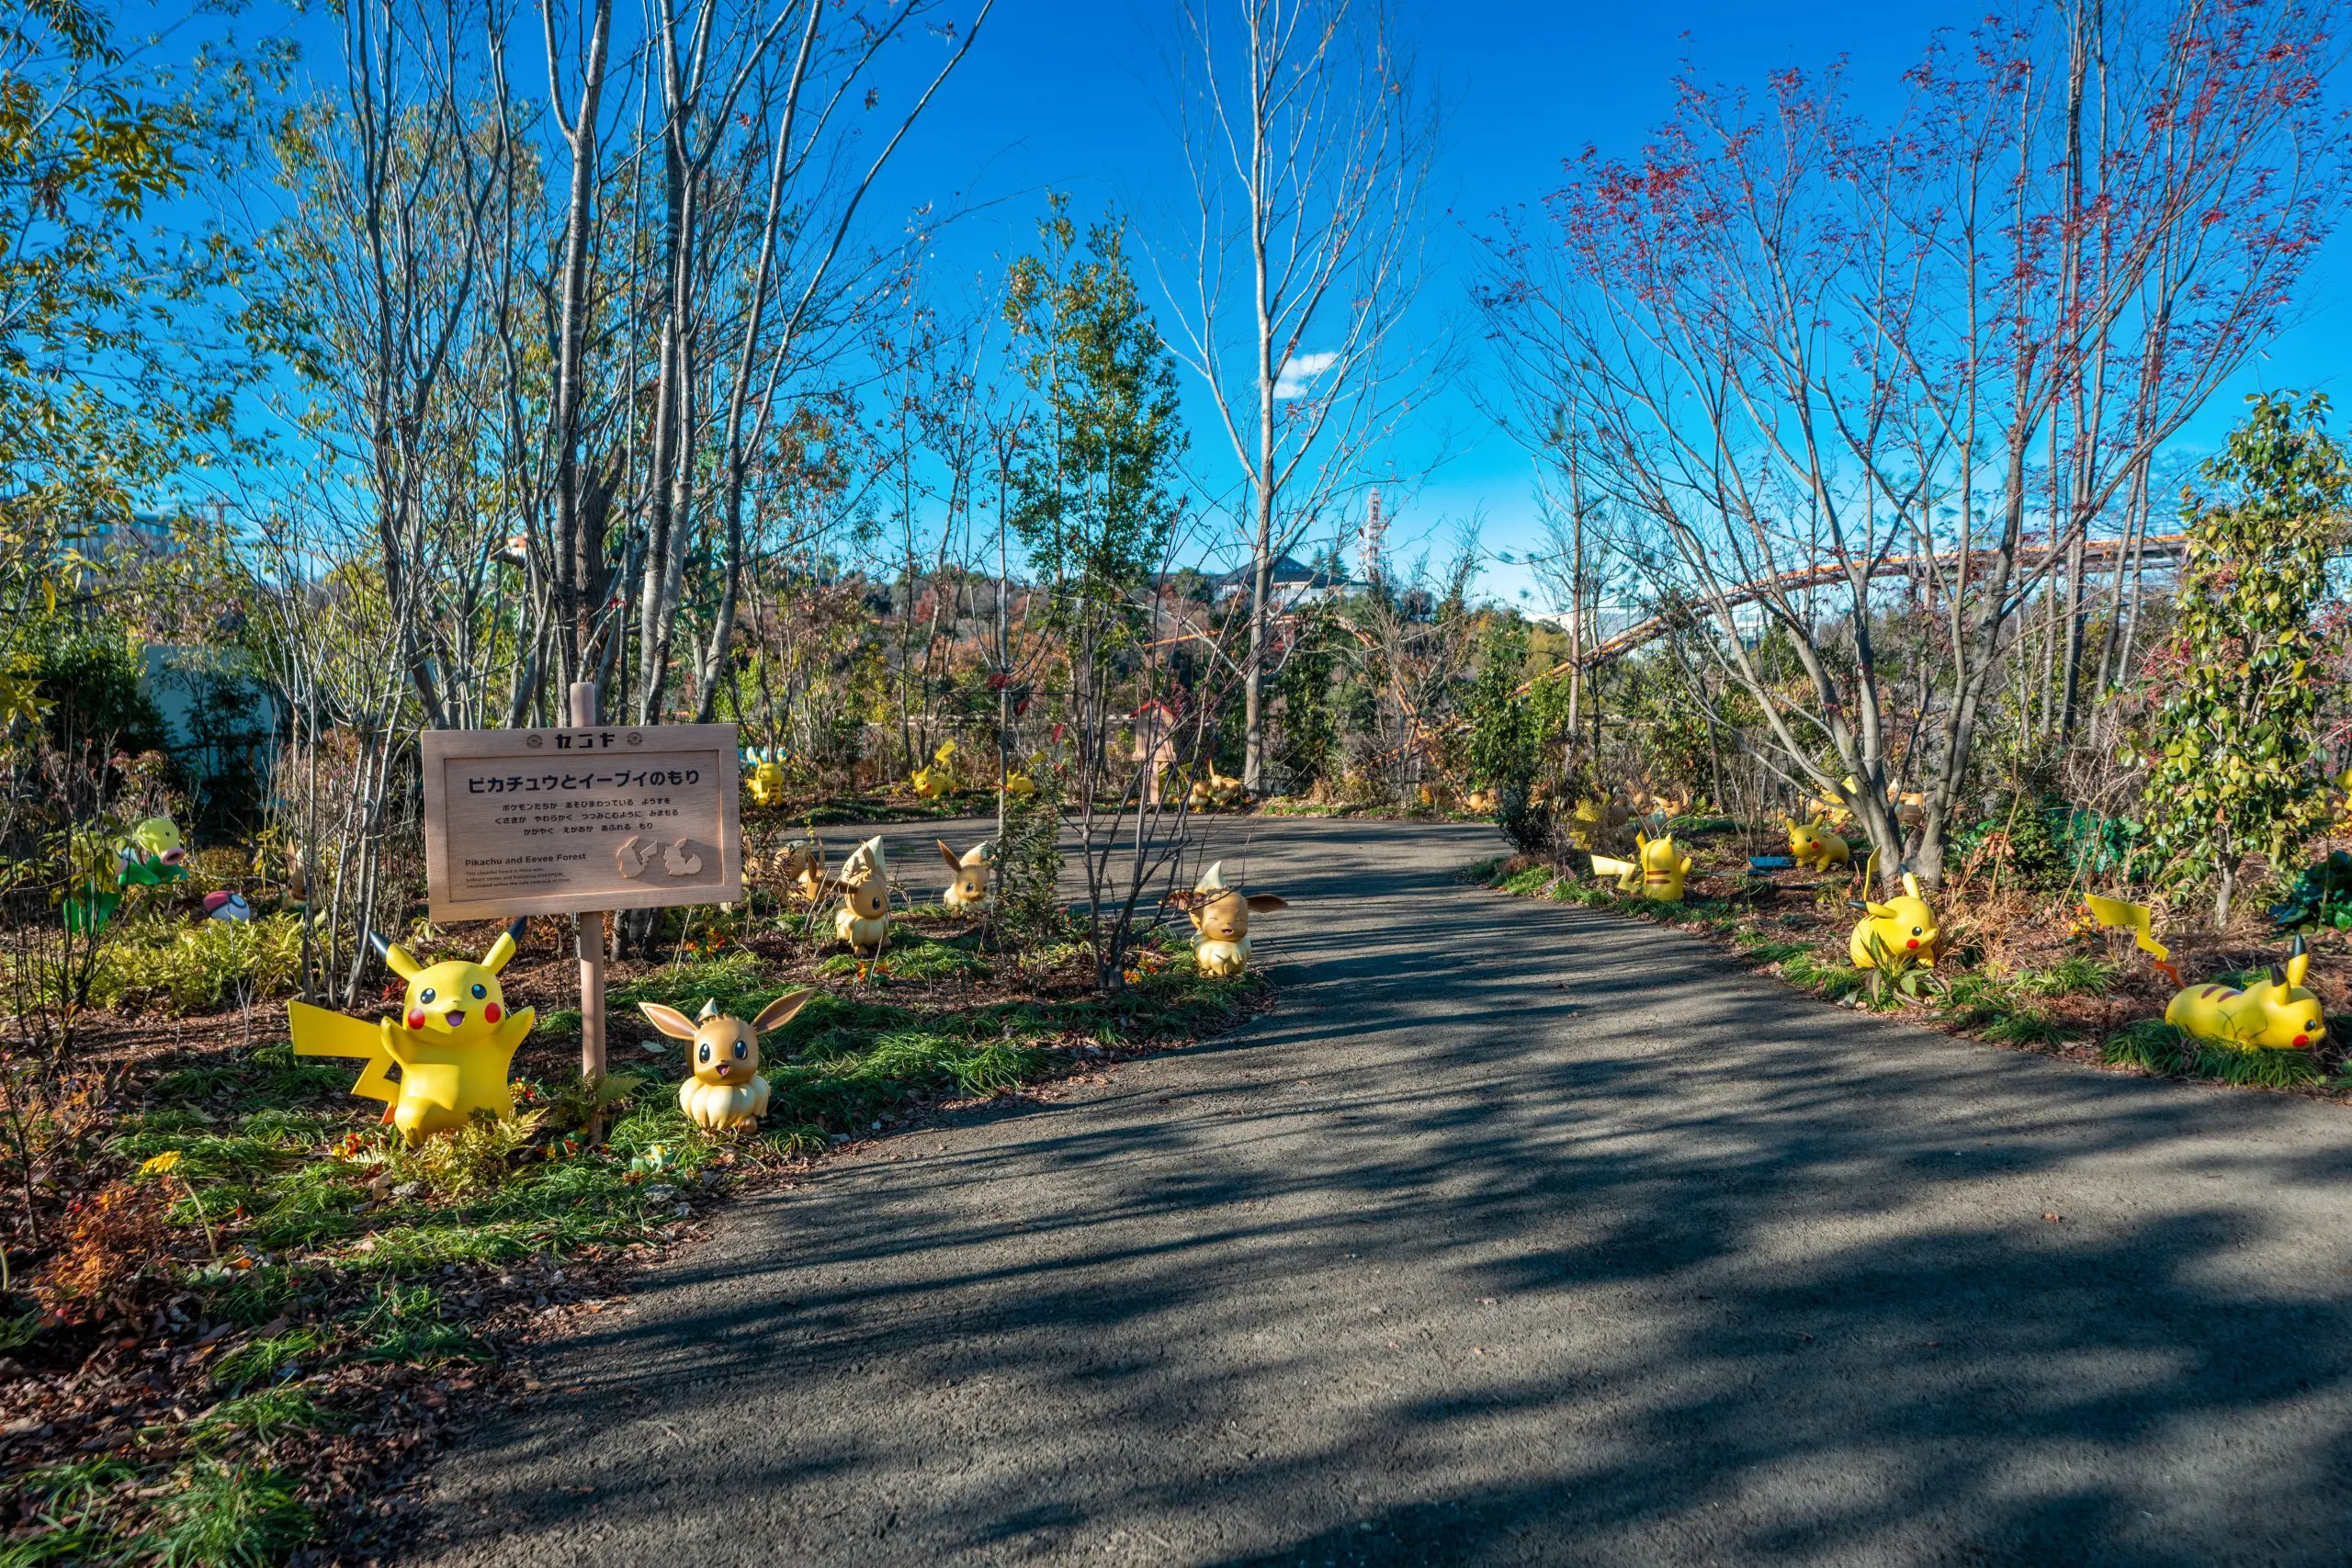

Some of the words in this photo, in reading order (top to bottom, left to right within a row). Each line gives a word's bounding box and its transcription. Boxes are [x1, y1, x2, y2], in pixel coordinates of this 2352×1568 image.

[469, 770, 700, 793] ピカチュウとイーブイのもり
[503, 803, 557, 811] ポケモンたちが
[566, 799, 634, 808] あそびまわっている
[535, 814, 572, 822] やわらかく
[581, 811, 641, 819] つつみこむように
[524, 828, 554, 836] かがやく
[562, 825, 594, 834] えがおが
[601, 823, 631, 832] あふれる
[465, 858, 502, 866] Pikachu
[505, 856, 522, 864] and
